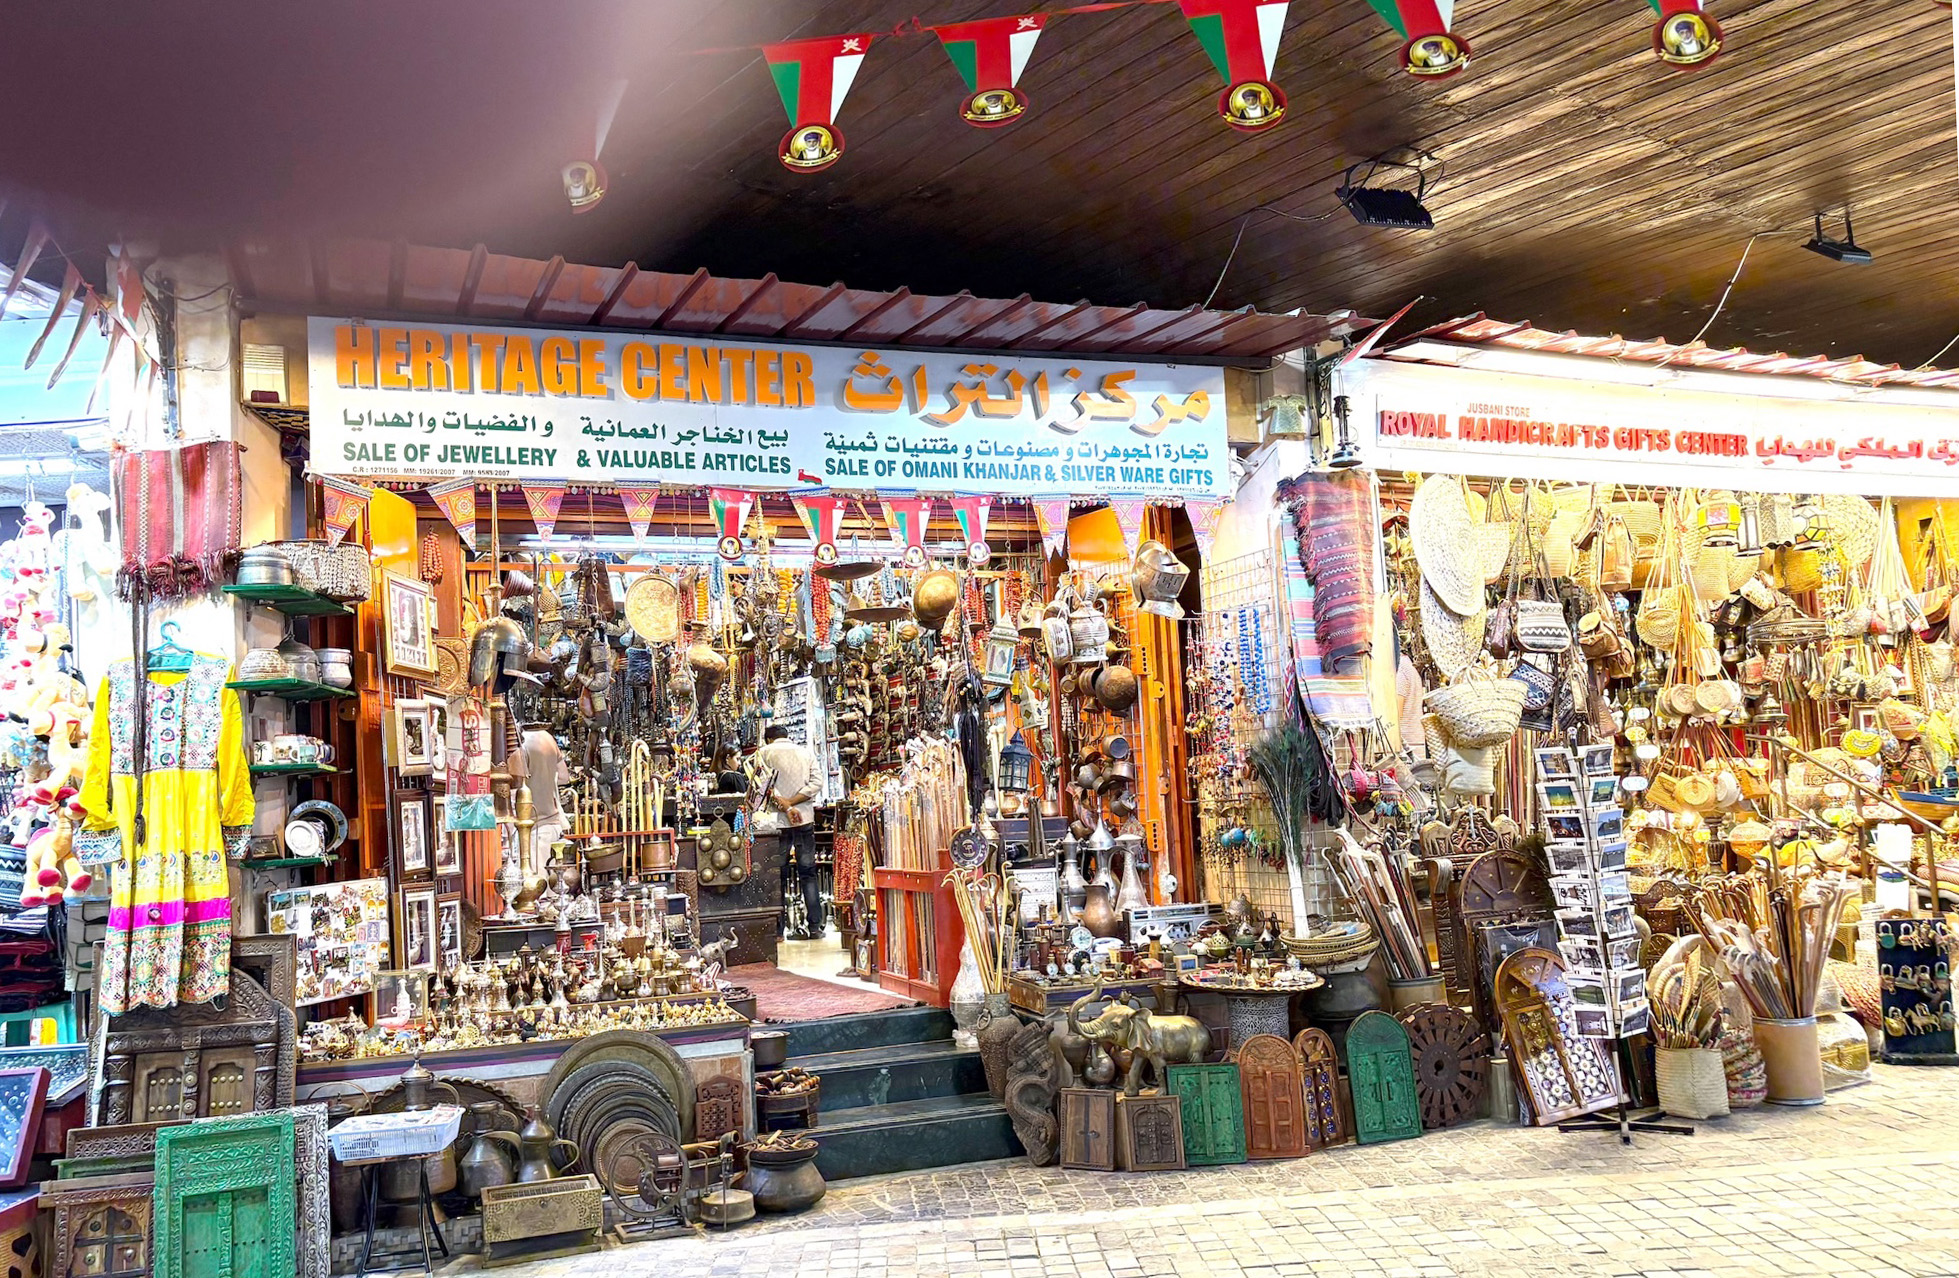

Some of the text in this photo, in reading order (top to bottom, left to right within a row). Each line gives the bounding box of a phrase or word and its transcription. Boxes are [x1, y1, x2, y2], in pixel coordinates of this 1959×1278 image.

[335, 326, 815, 408] HERITAGE CENTER
[836, 350, 1211, 438] مركز التراث
[343, 408, 437, 433] والهدايا
[1467, 402, 1531, 418] JUSBANI STORE
[580, 416, 666, 442] العمانية
[671, 425, 752, 447] الخناجر
[757, 428, 789, 449] بيع
[1380, 410, 1749, 457] ROYAL HANDICRAFTS GIFTS CENTER
[823, 431, 878, 455] ثمينة
[884, 436, 958, 459] مقتنيات
[977, 439, 1059, 462] مصنوعات
[1077, 441, 1160, 463] المجوهرات
[1164, 443, 1209, 463] تجارة
[1755, 435, 1836, 466] للهدايا
[1838, 437, 1923, 469] الملكي
[343, 442, 791, 474] SALE OF JEWELLERY & VALUABLE ARTICLES
[825, 457, 1213, 486] SALE OF OMANI KHANJAR & SILVER WARE GIFTS
